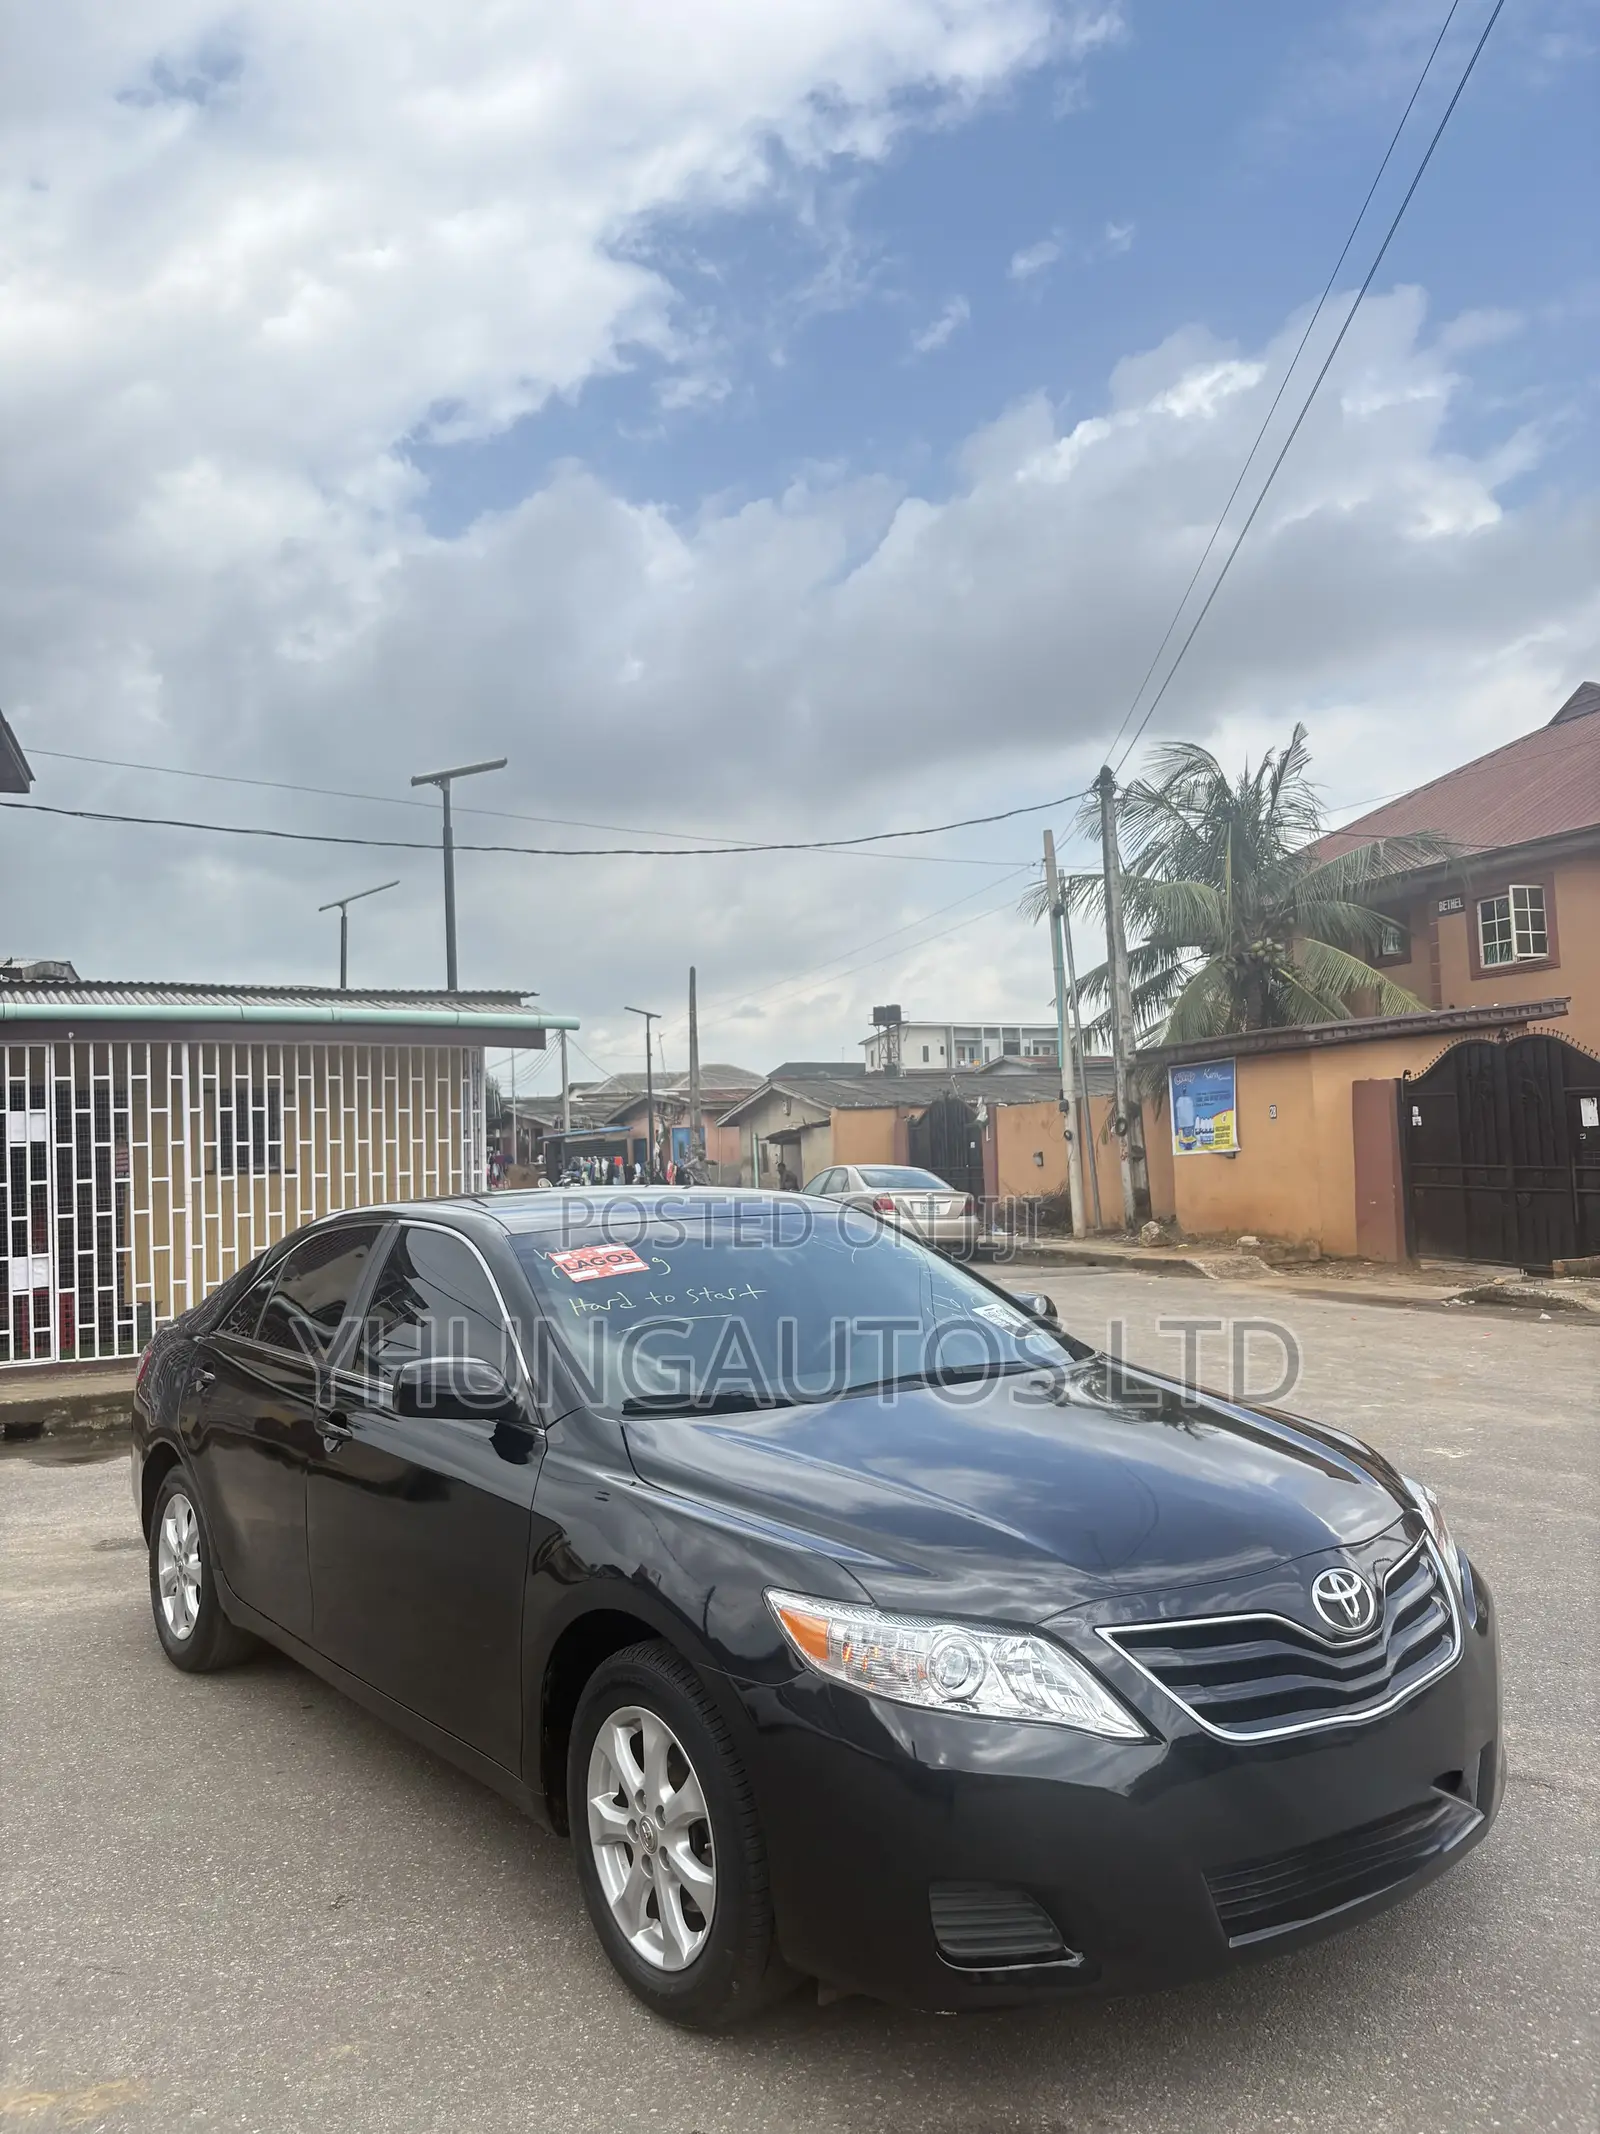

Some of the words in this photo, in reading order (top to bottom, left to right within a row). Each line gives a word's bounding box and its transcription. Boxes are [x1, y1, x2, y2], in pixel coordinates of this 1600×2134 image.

[1438, 897, 1464, 912] BETHEL
[562, 1252, 636, 1272] LAGOS
[569, 1291, 637, 1316] Hard
[645, 1290, 676, 1305] to
